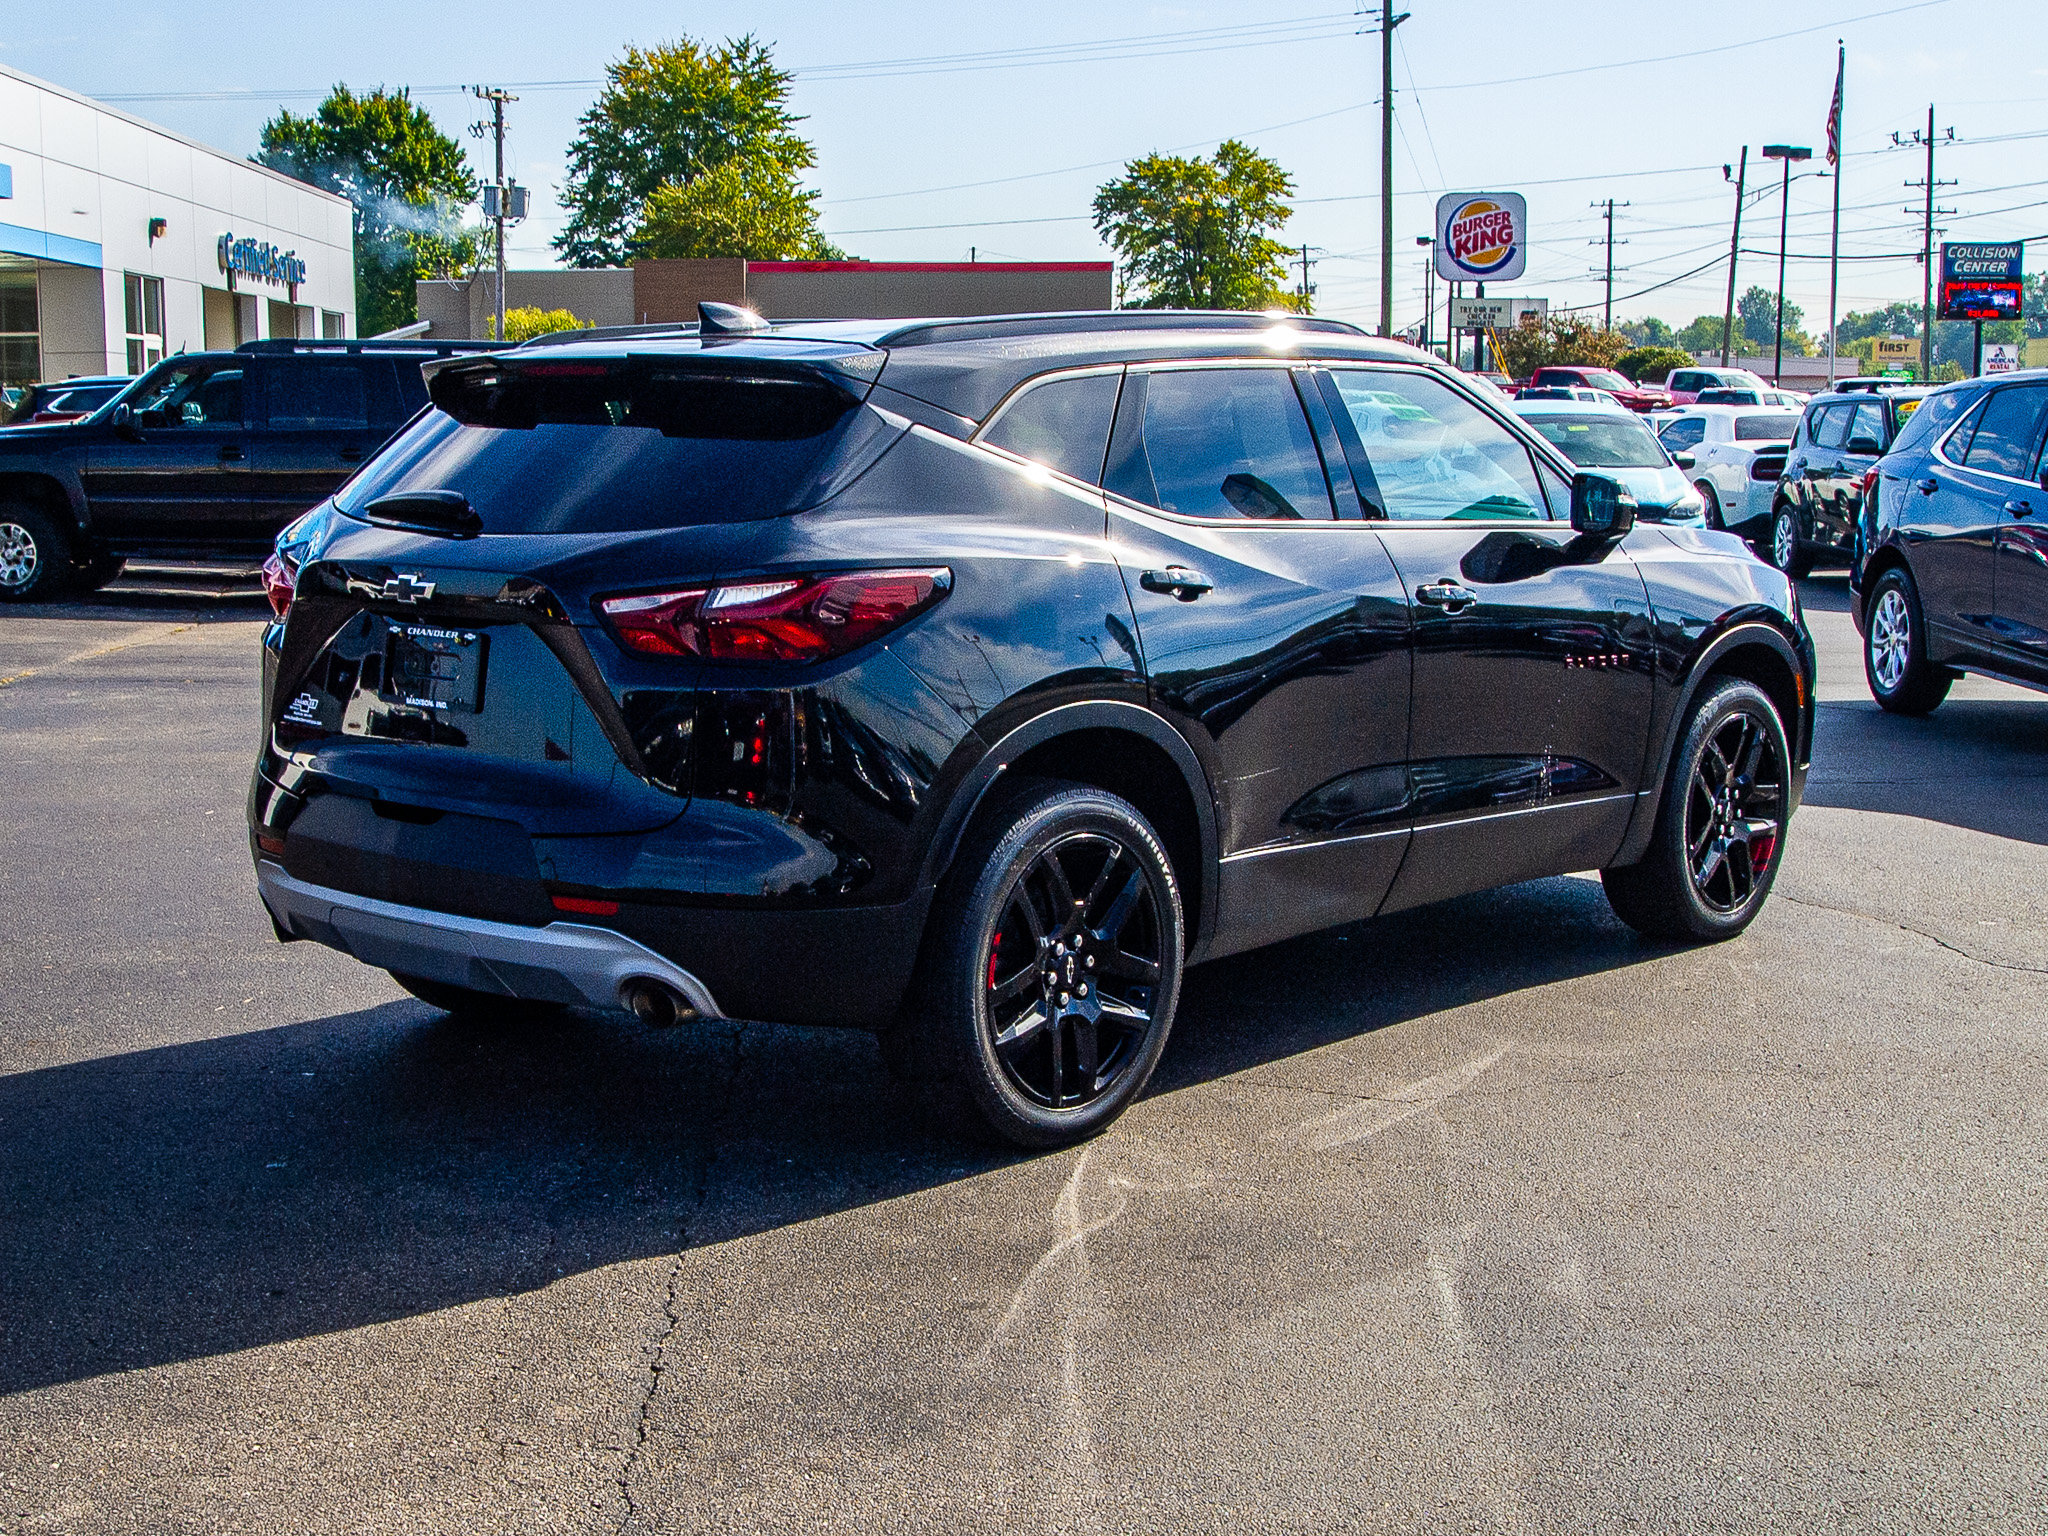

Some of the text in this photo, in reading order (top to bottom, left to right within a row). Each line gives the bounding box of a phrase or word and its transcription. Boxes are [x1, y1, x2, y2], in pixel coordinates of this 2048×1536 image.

[1452, 210, 1512, 240] BURGER
[1455, 224, 1514, 259] KING
[222, 232, 270, 277] Certified
[1948, 246, 2018, 259] COLLISION
[1954, 260, 2008, 273] CENTER
[407, 627, 459, 639] CHANDLER
